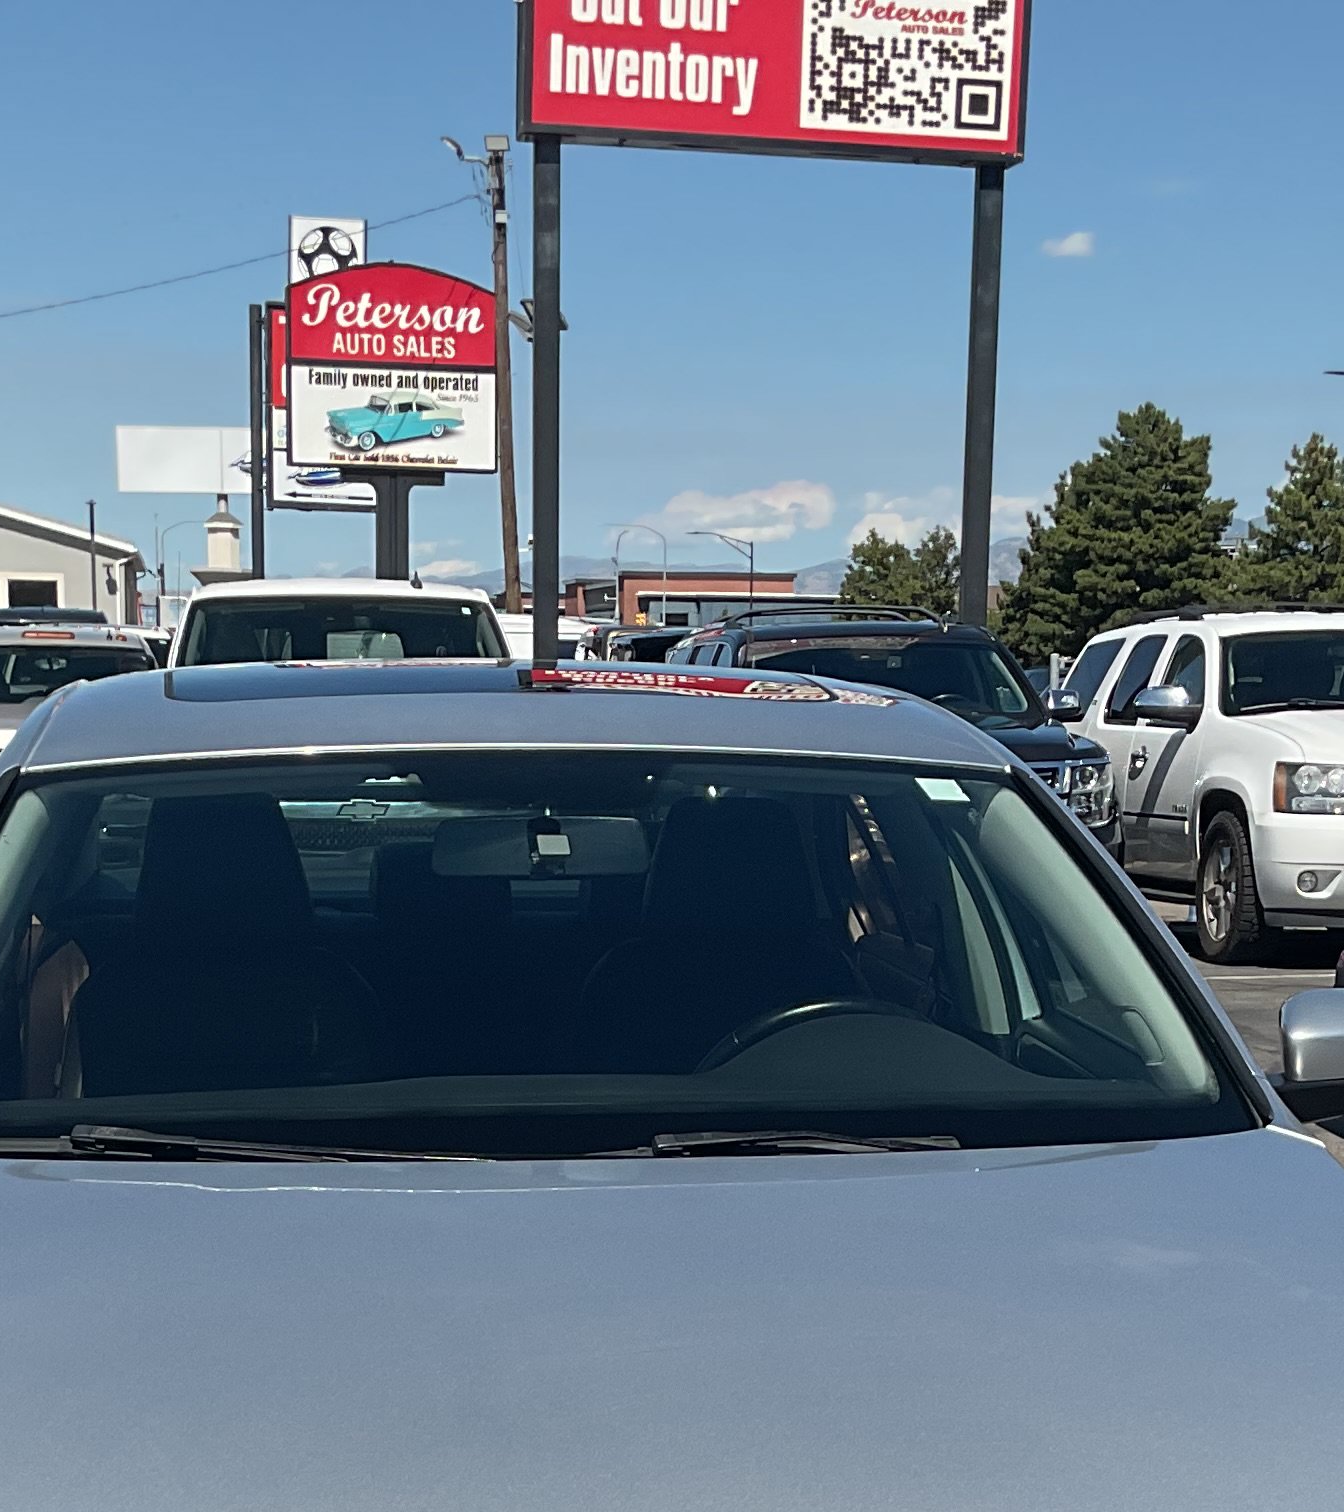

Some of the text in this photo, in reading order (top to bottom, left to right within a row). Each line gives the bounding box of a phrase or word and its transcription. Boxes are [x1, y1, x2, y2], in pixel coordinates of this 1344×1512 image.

[850, 0, 968, 25] Peterson
[901, 24, 965, 36] AUTO SALES
[549, 32, 759, 116] Inventory
[301, 283, 485, 334] Peterson
[332, 332, 456, 359] AUTO SALES
[308, 368, 479, 392] Family owned and operated
